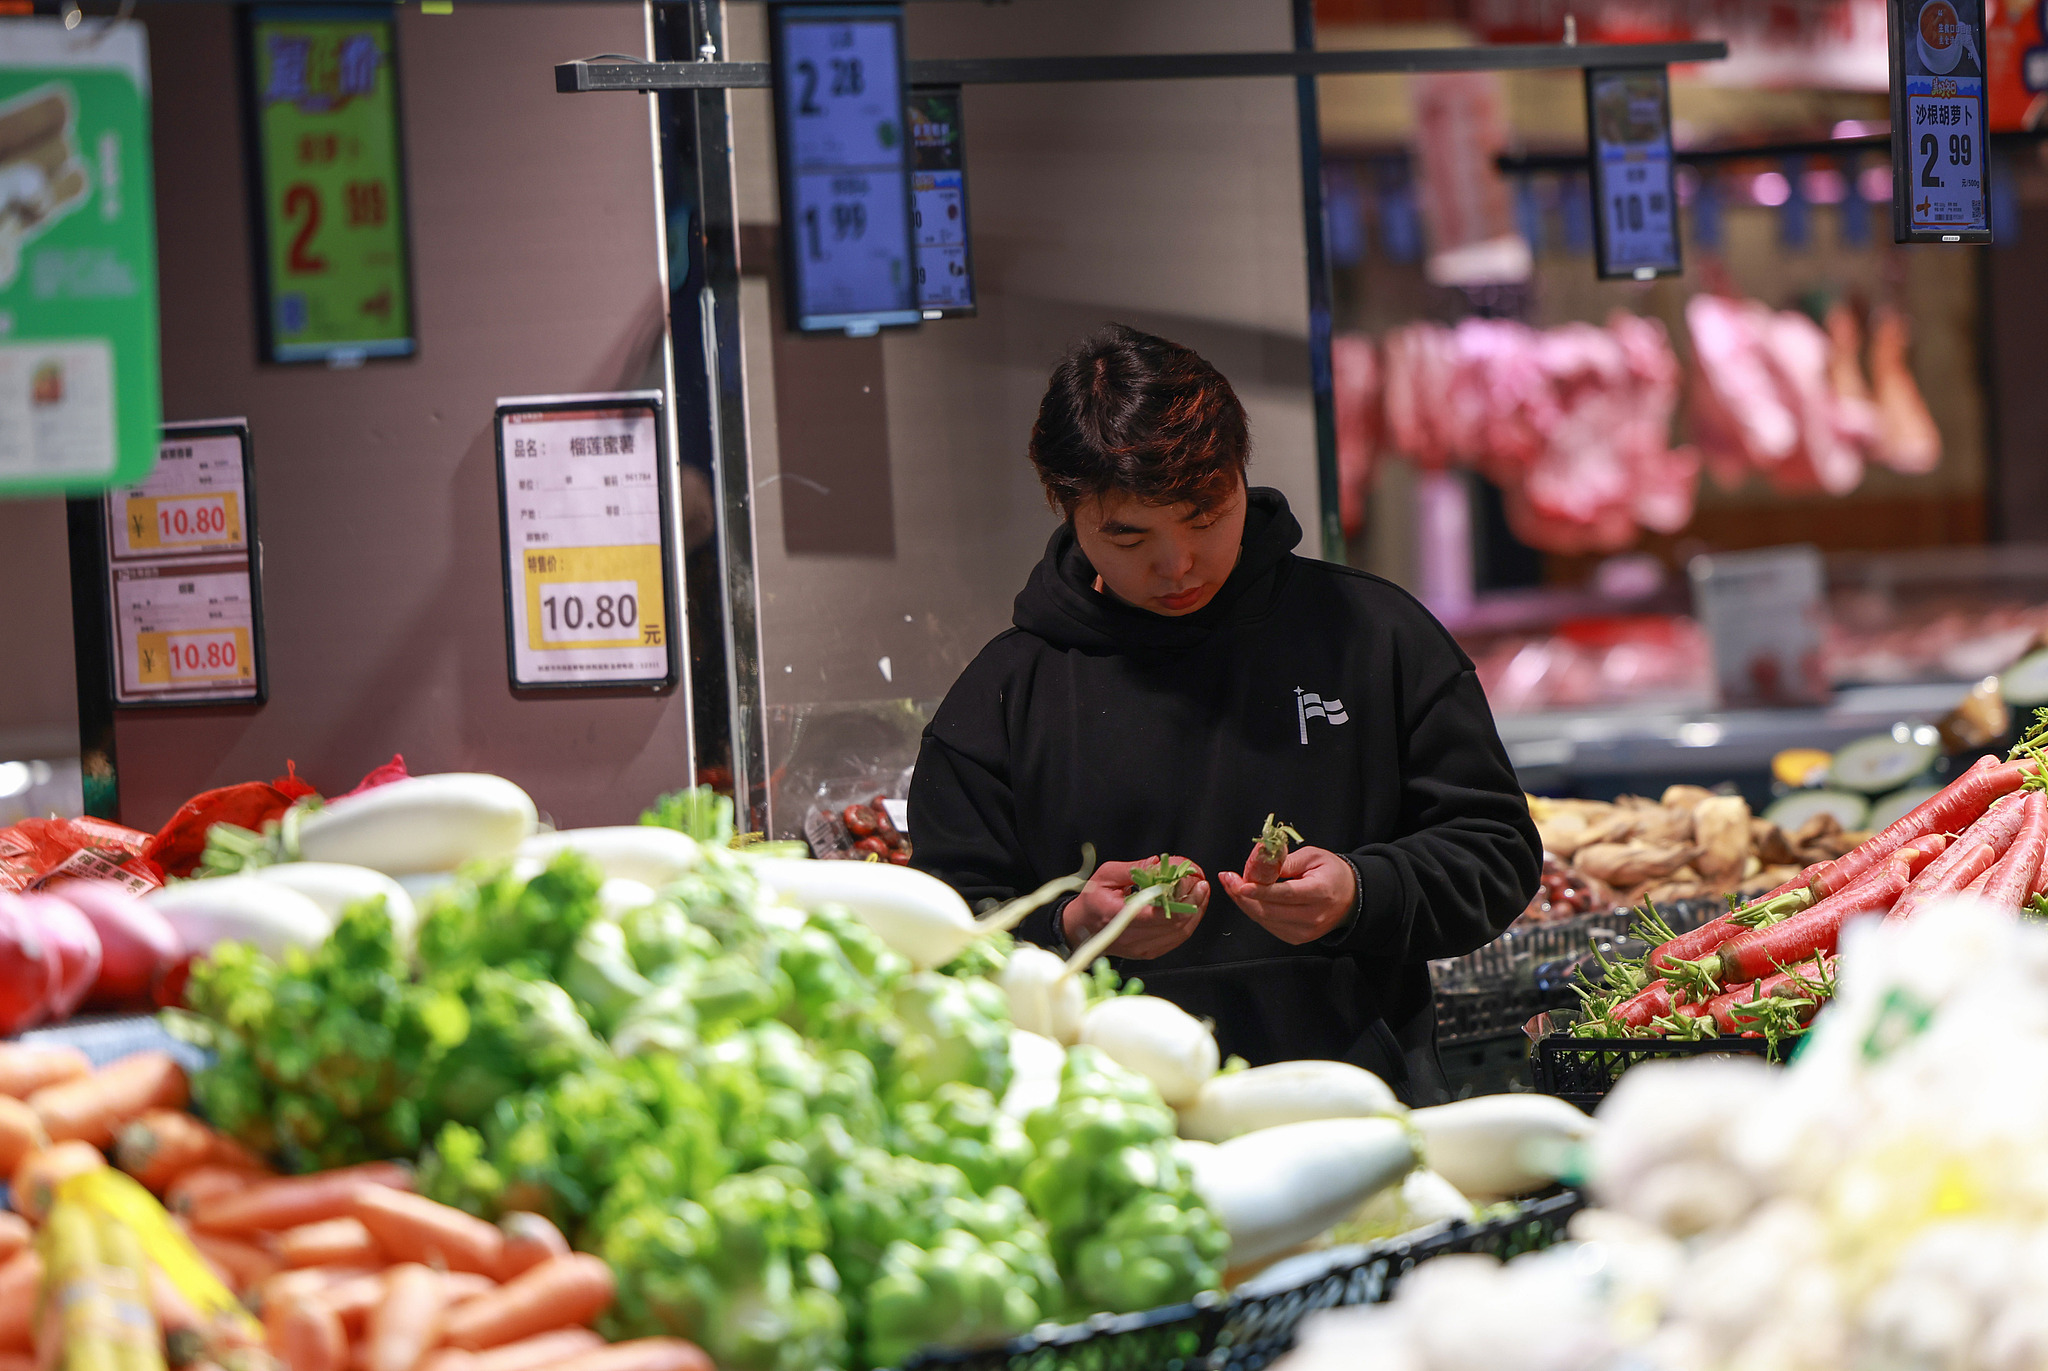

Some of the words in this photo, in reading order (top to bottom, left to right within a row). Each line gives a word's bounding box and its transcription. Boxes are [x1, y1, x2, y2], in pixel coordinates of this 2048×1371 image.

[1915, 104, 1973, 126] 沙根胡萝卜
[1961, 178, 1980, 188] 元/500g
[514, 439, 546, 458] 品名：
[570, 434, 635, 458] 榴莲蜜薯
[159, 505, 226, 537] 10.80
[544, 593, 638, 631] 10.80
[643, 624, 662, 645] 元
[170, 641, 237, 671] 10.80
